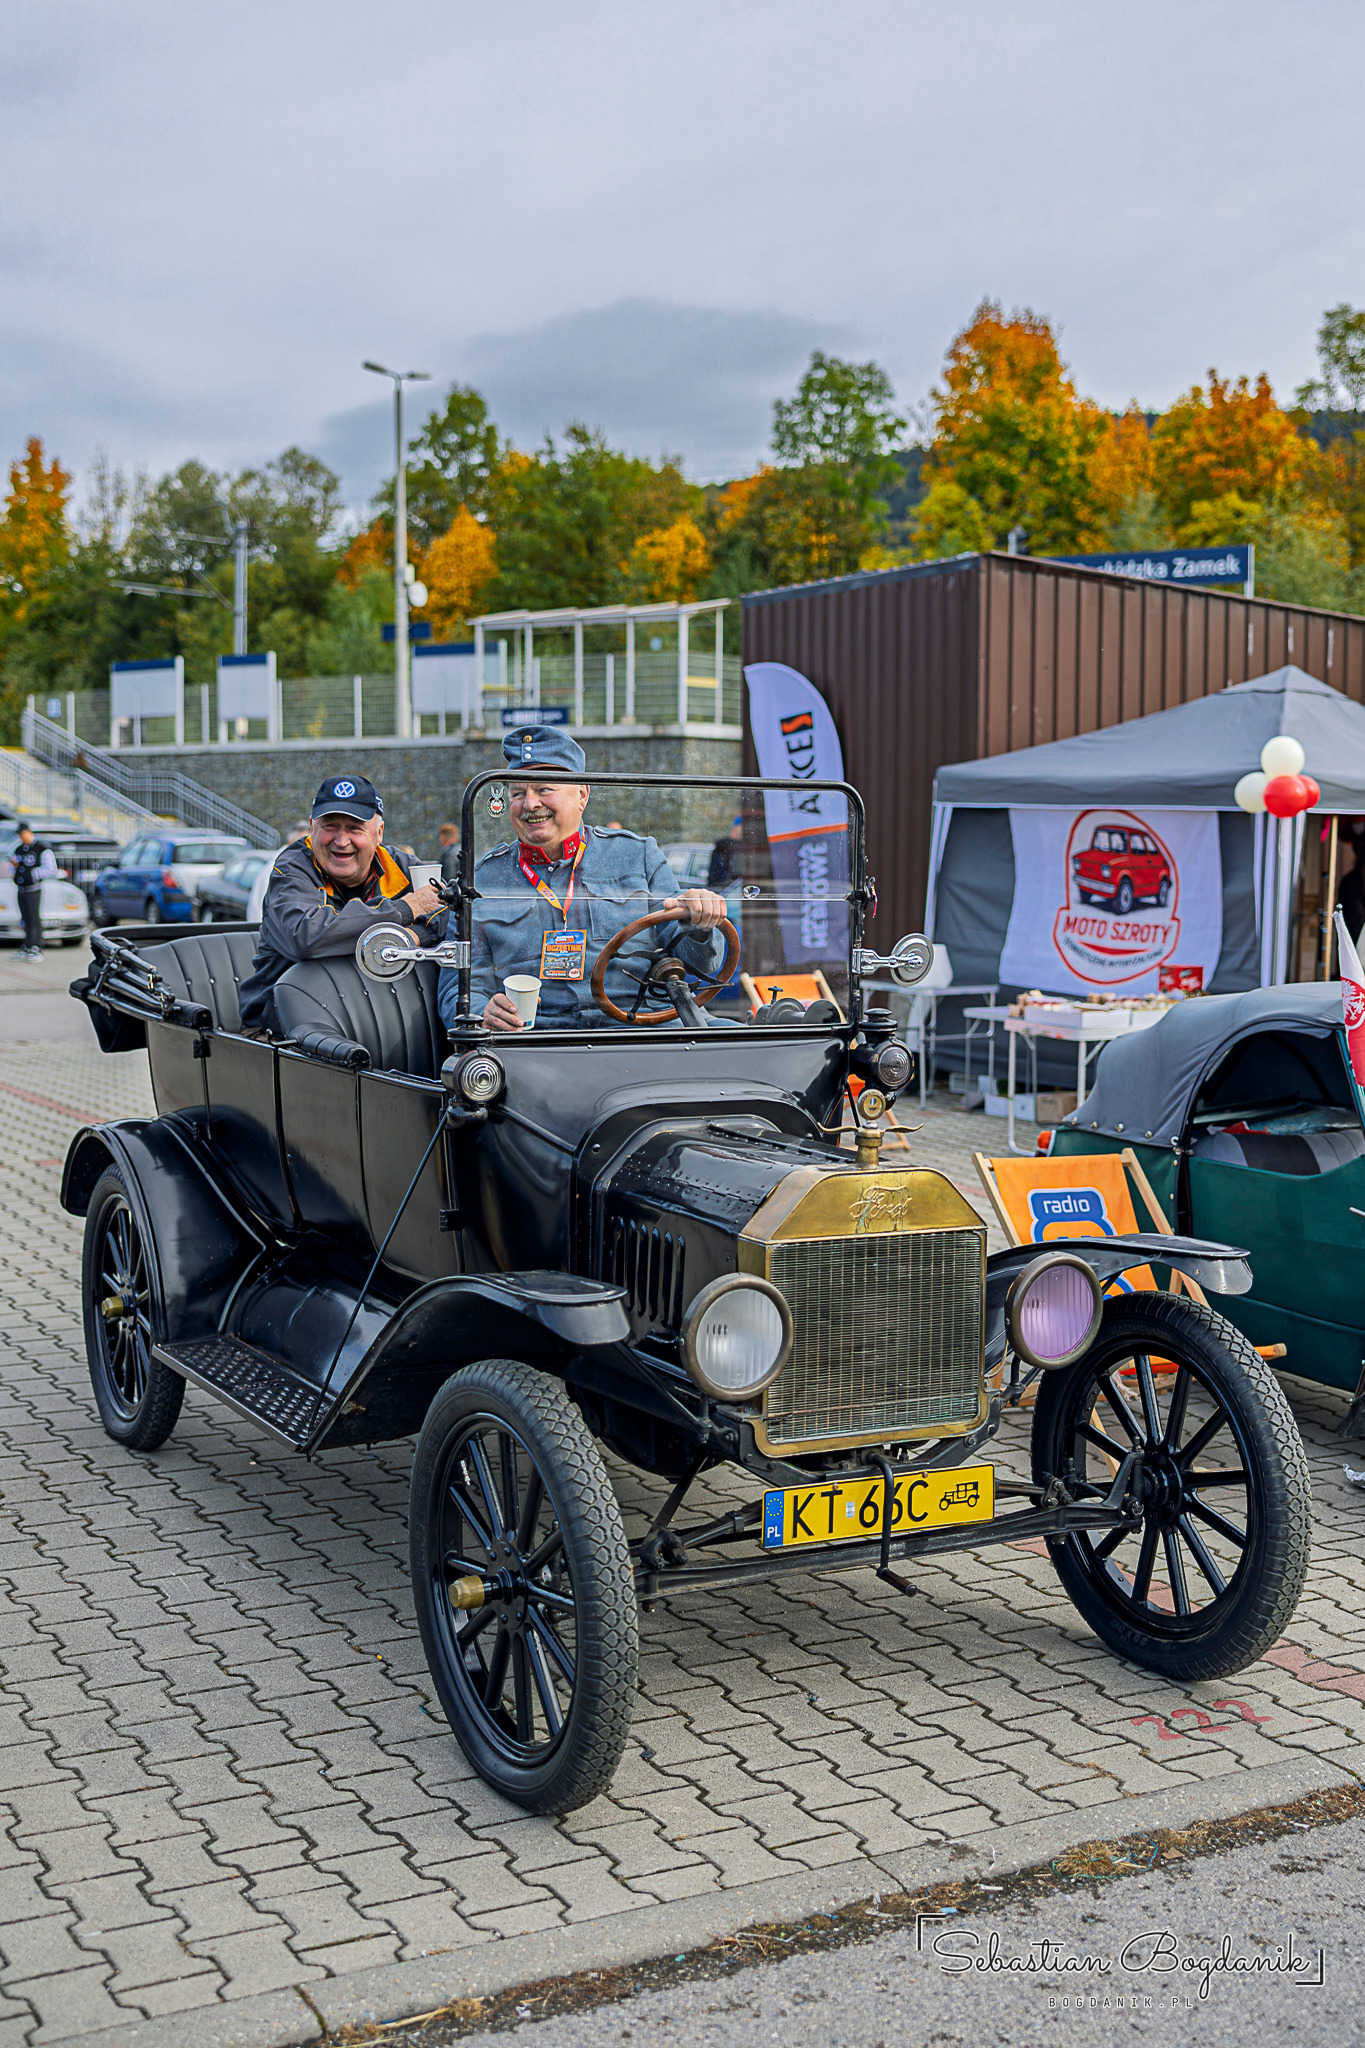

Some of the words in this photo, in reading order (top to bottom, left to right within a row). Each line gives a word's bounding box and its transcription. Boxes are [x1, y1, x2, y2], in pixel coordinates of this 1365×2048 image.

[1172, 553, 1241, 578] Zamek
[1062, 915, 1108, 939] MOTO
[1110, 921, 1172, 944] SZROTY
[848, 1196, 912, 1220] Ford
[1043, 1194, 1090, 1214] radio
[791, 1488, 844, 1539] KT
[766, 1526, 782, 1539] PL
[1130, 1699, 1276, 1741] 222
